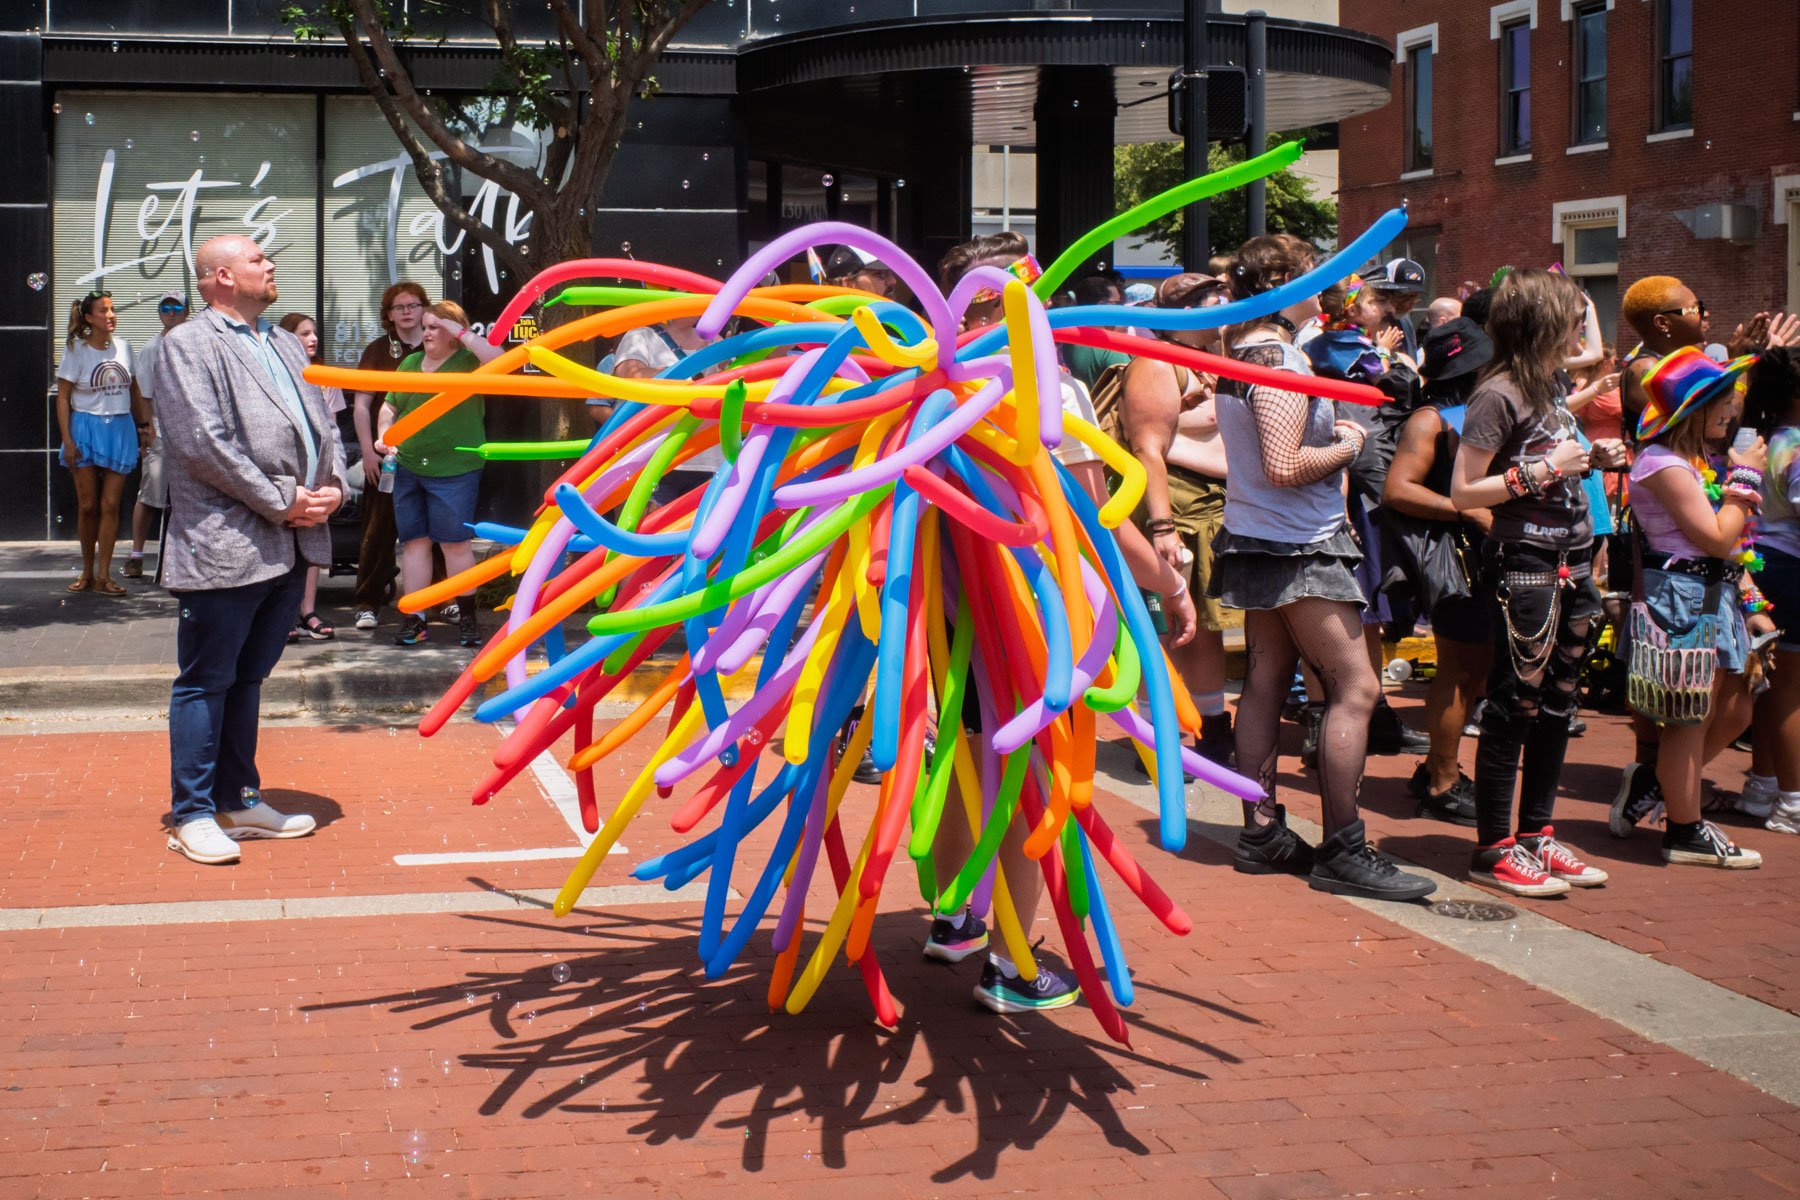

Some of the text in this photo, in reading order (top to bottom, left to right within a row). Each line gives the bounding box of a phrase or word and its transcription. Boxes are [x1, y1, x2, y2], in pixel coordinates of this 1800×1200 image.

[75, 145, 536, 295] Let's Talk
[513, 323, 541, 339] Tuc
